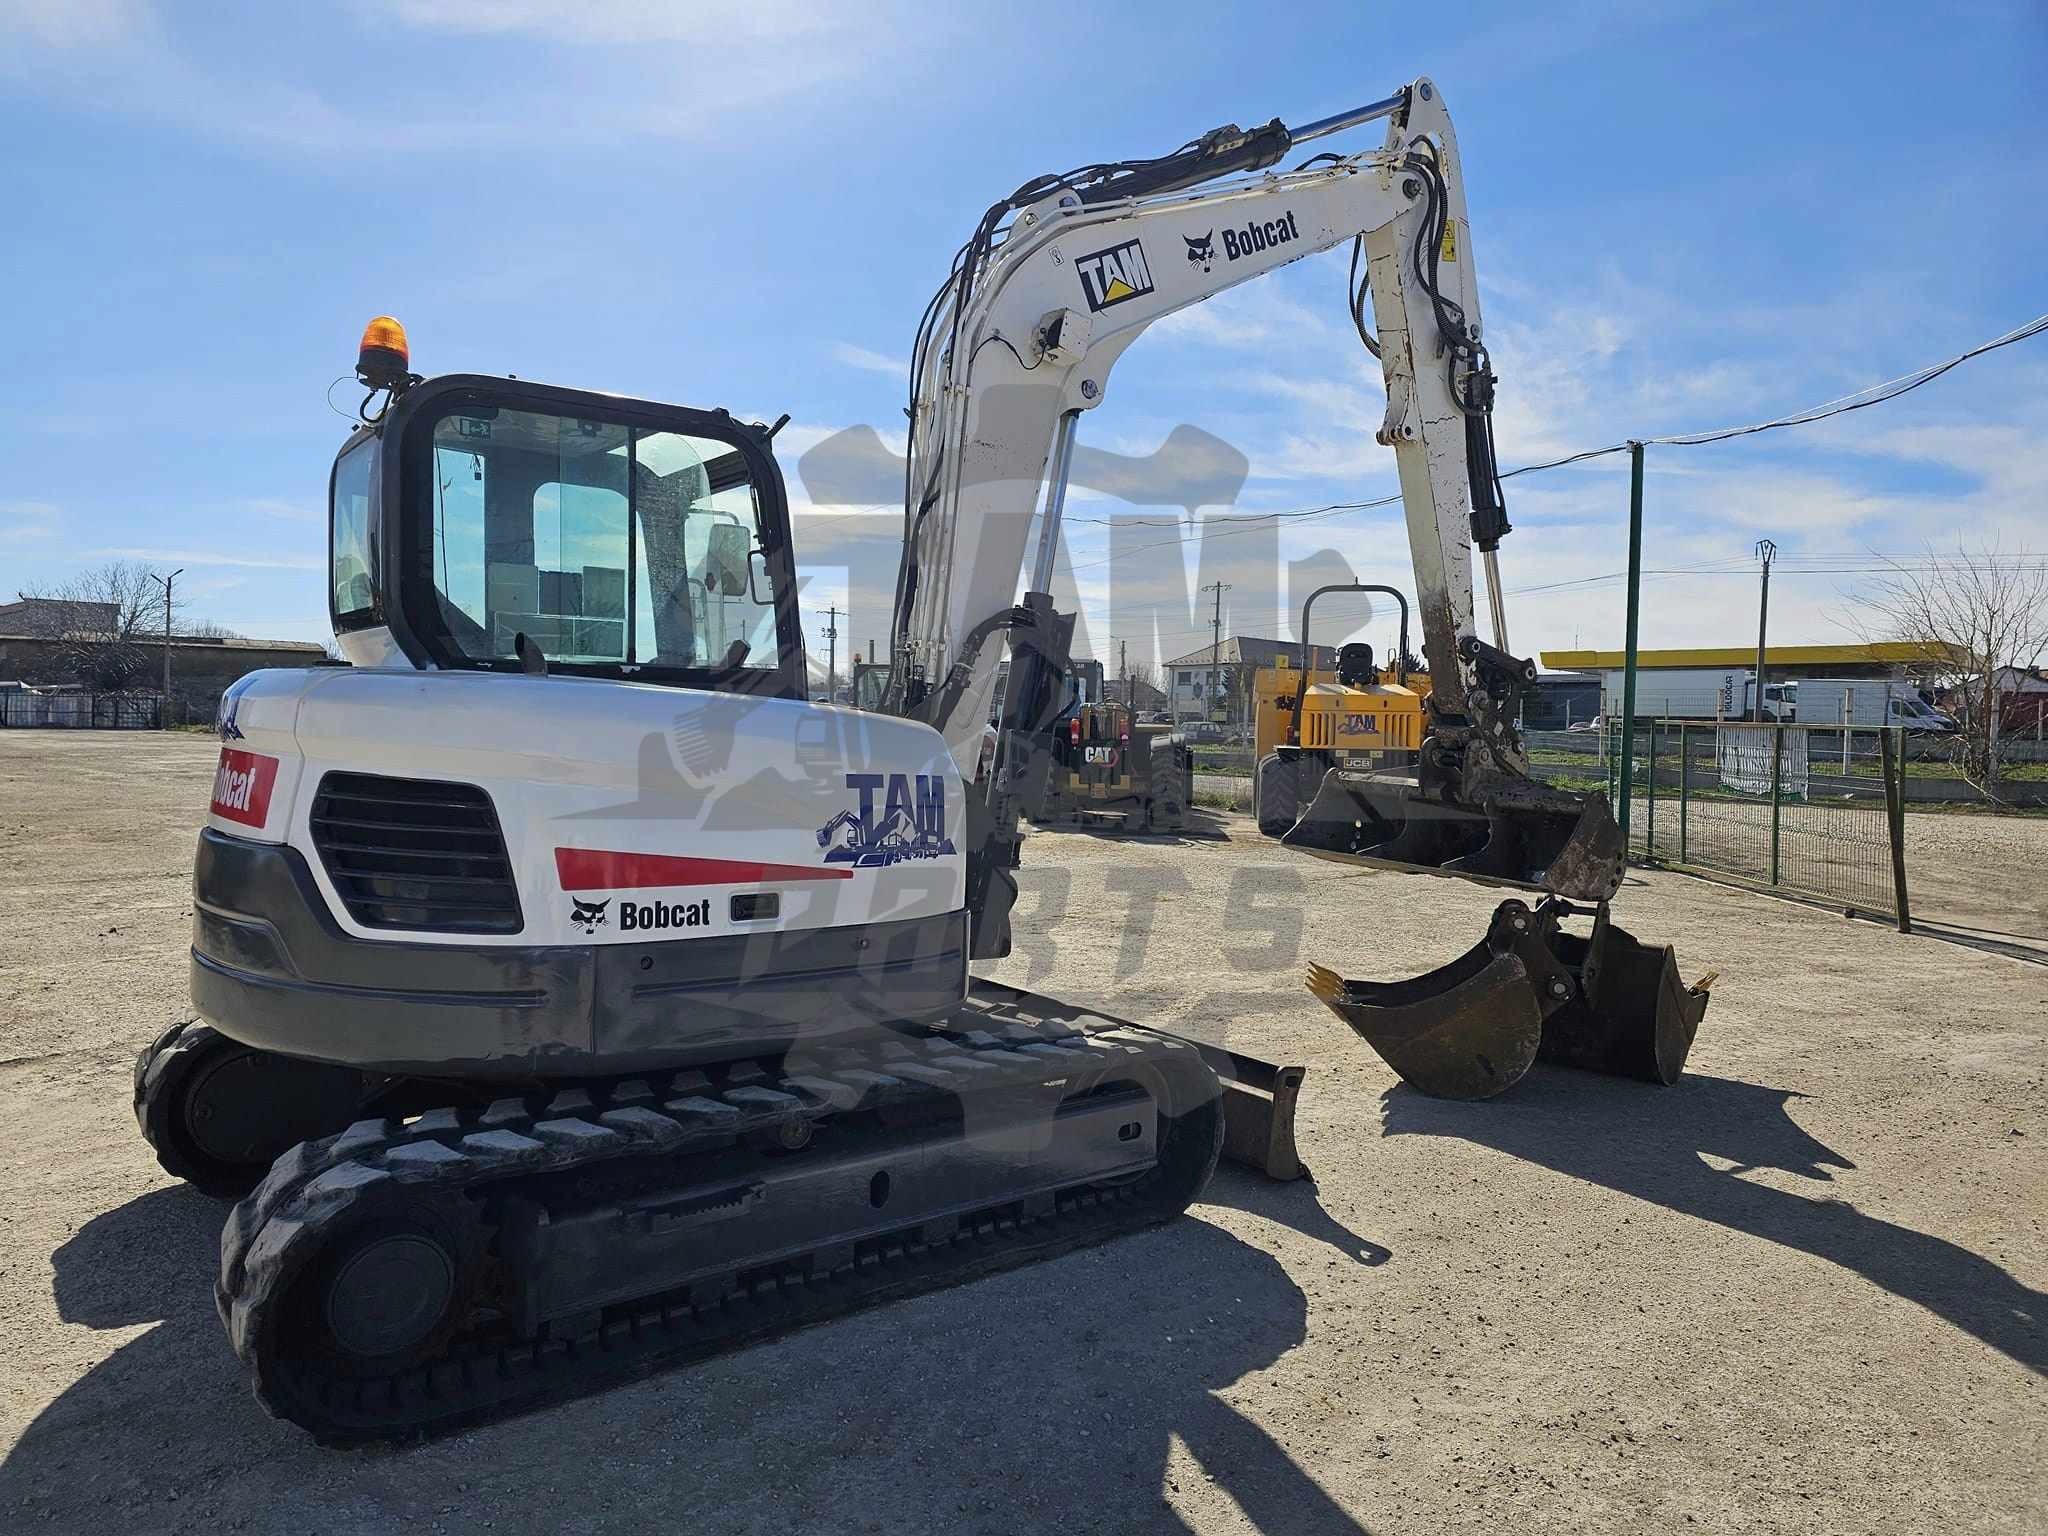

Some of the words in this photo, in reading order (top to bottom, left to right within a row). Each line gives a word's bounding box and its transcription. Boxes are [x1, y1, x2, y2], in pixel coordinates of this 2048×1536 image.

[1222, 211, 1299, 261] Bobcat
[1078, 244, 1152, 305] TAM
[1344, 714, 1376, 731] TAM
[1085, 746, 1112, 763] CAT
[1345, 759, 1371, 768] JCB
[846, 773, 945, 846] TAM
[620, 899, 710, 930] Bobcat
